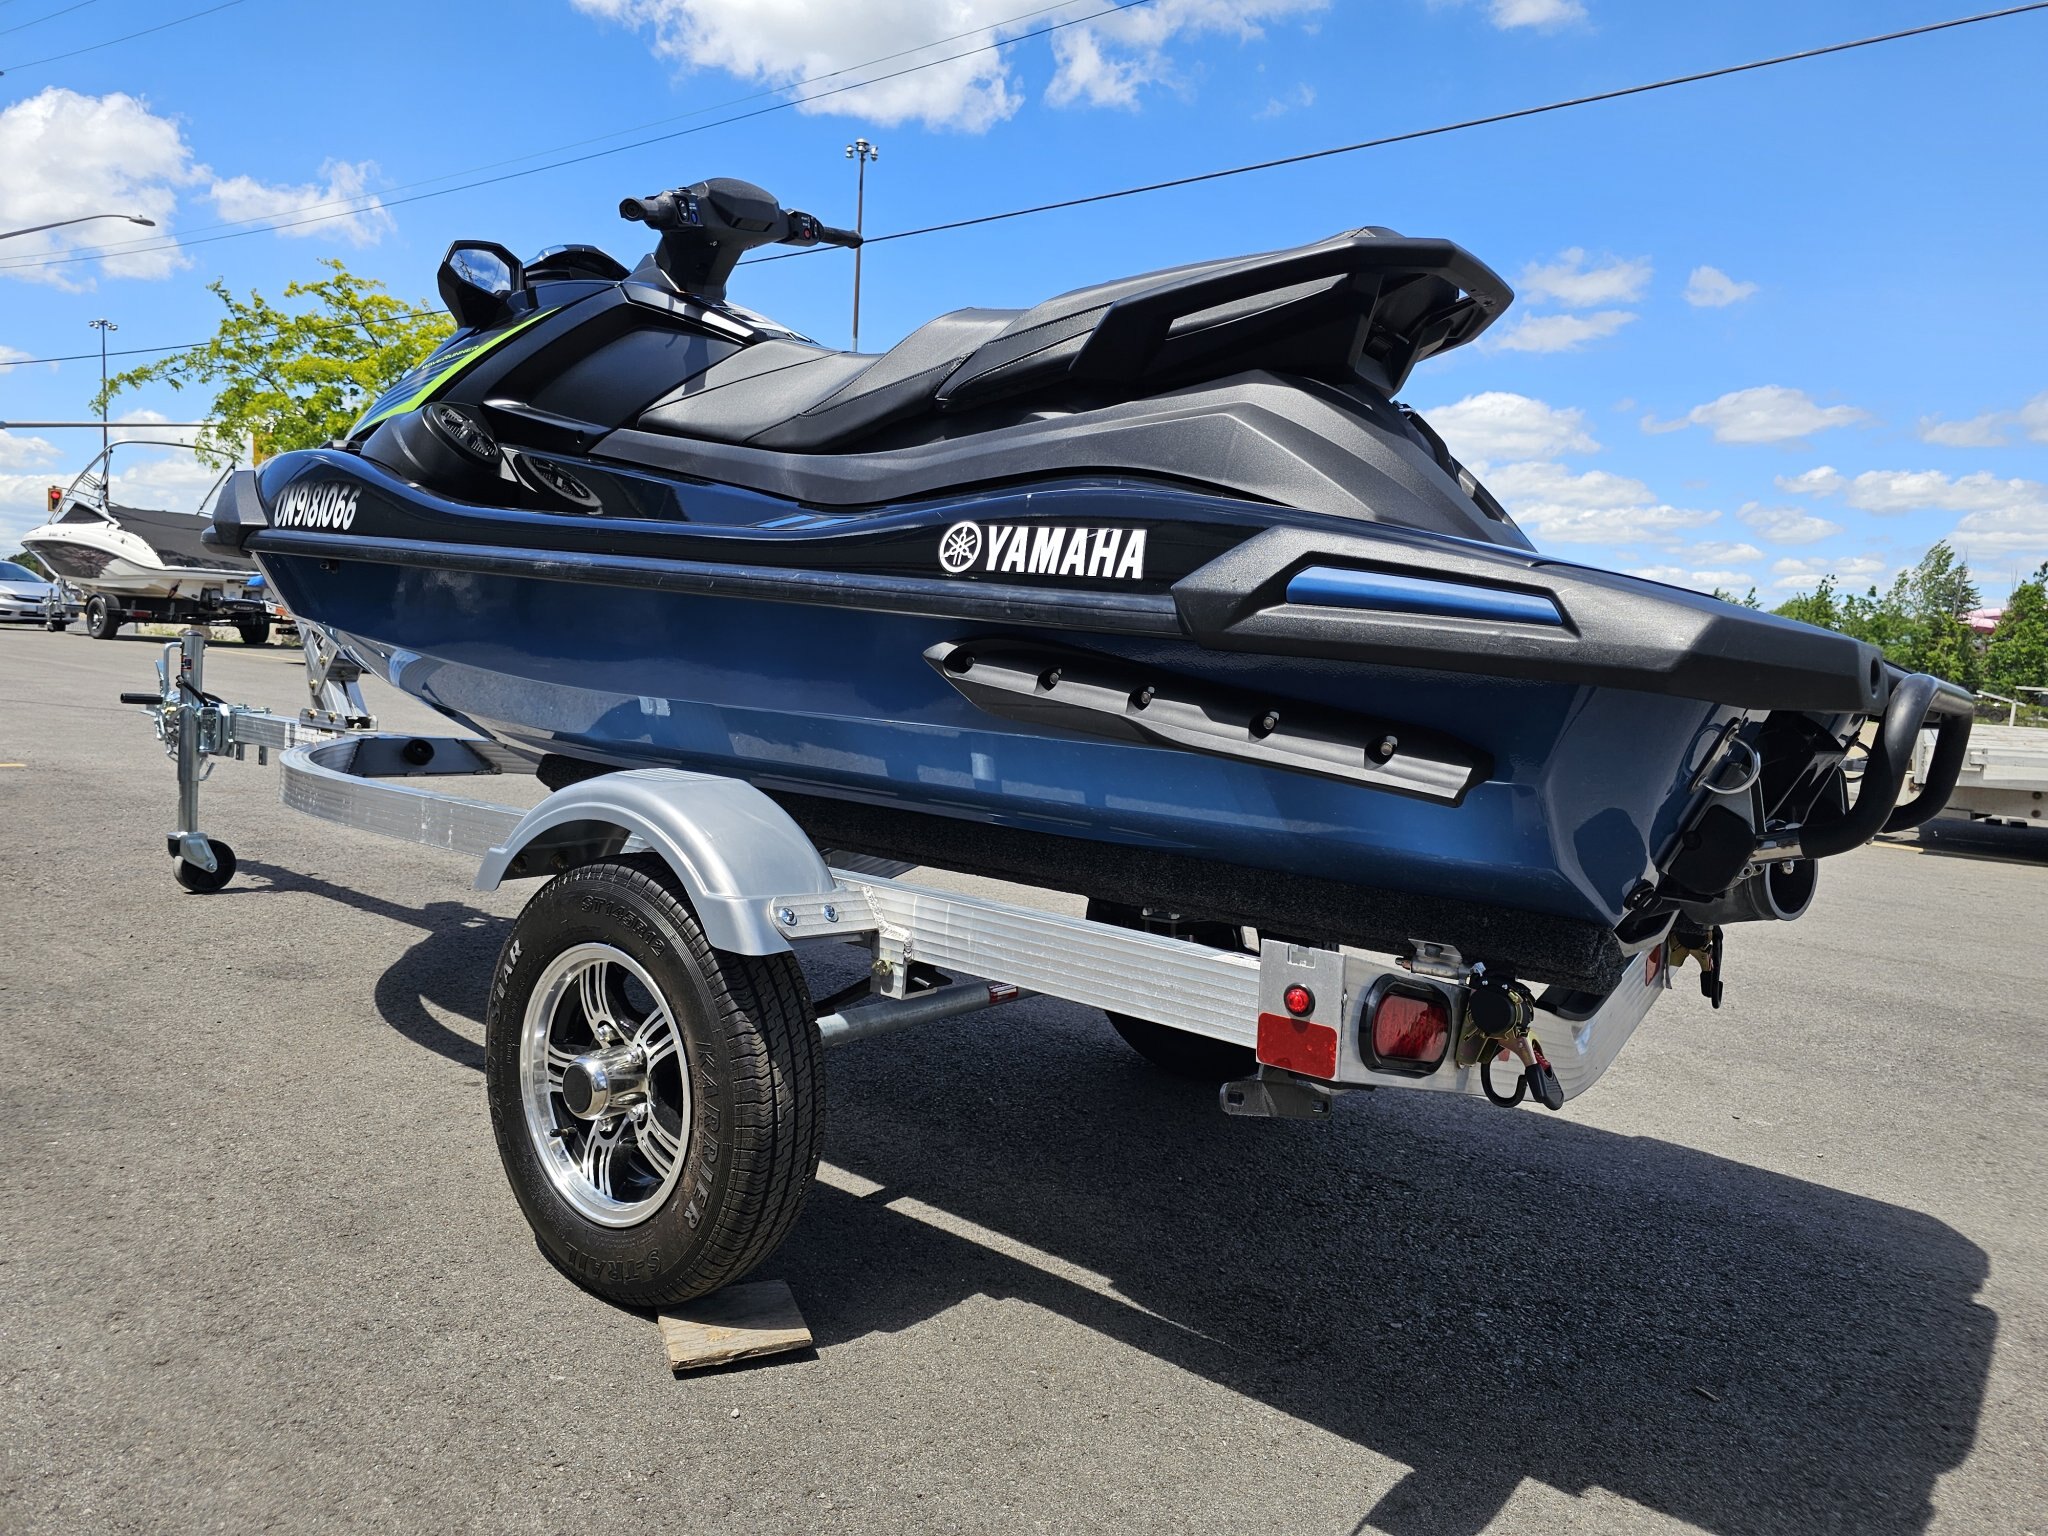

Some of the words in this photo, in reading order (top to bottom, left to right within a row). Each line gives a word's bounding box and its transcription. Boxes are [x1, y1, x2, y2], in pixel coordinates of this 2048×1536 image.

[274, 484, 361, 530] ON9181066
[986, 525, 1147, 579] YAMAHA
[581, 895, 665, 957] ST145R12
[492, 938, 522, 1024] STAR
[684, 1042, 721, 1229] KARRIER
